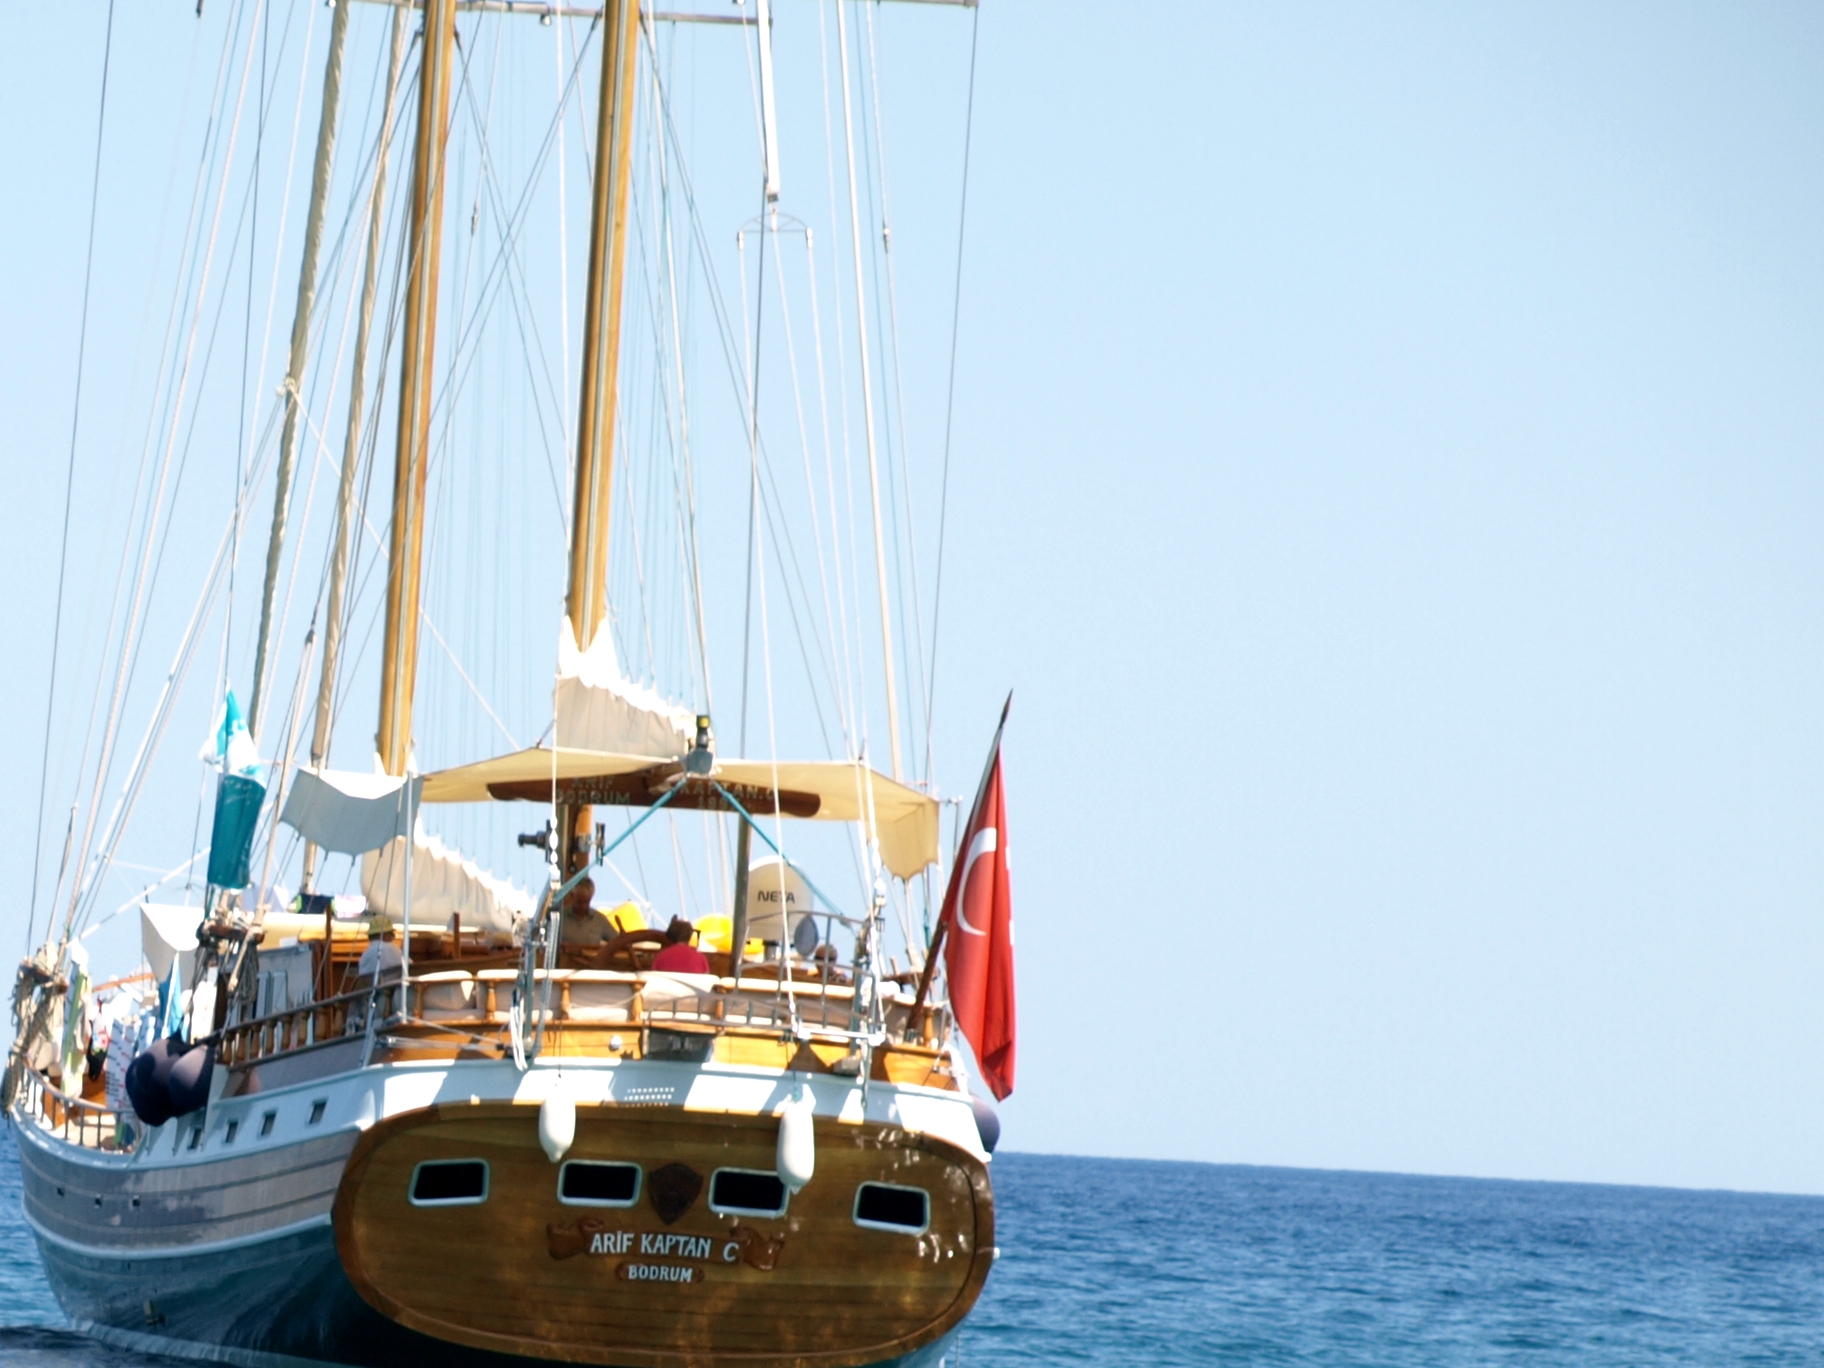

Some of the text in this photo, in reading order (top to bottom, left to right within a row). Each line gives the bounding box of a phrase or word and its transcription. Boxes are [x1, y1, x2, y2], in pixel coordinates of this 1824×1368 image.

[640, 1232, 712, 1259] KAPTAN
[722, 1242, 739, 1262] C
[628, 1264, 693, 1283] BODRUM
